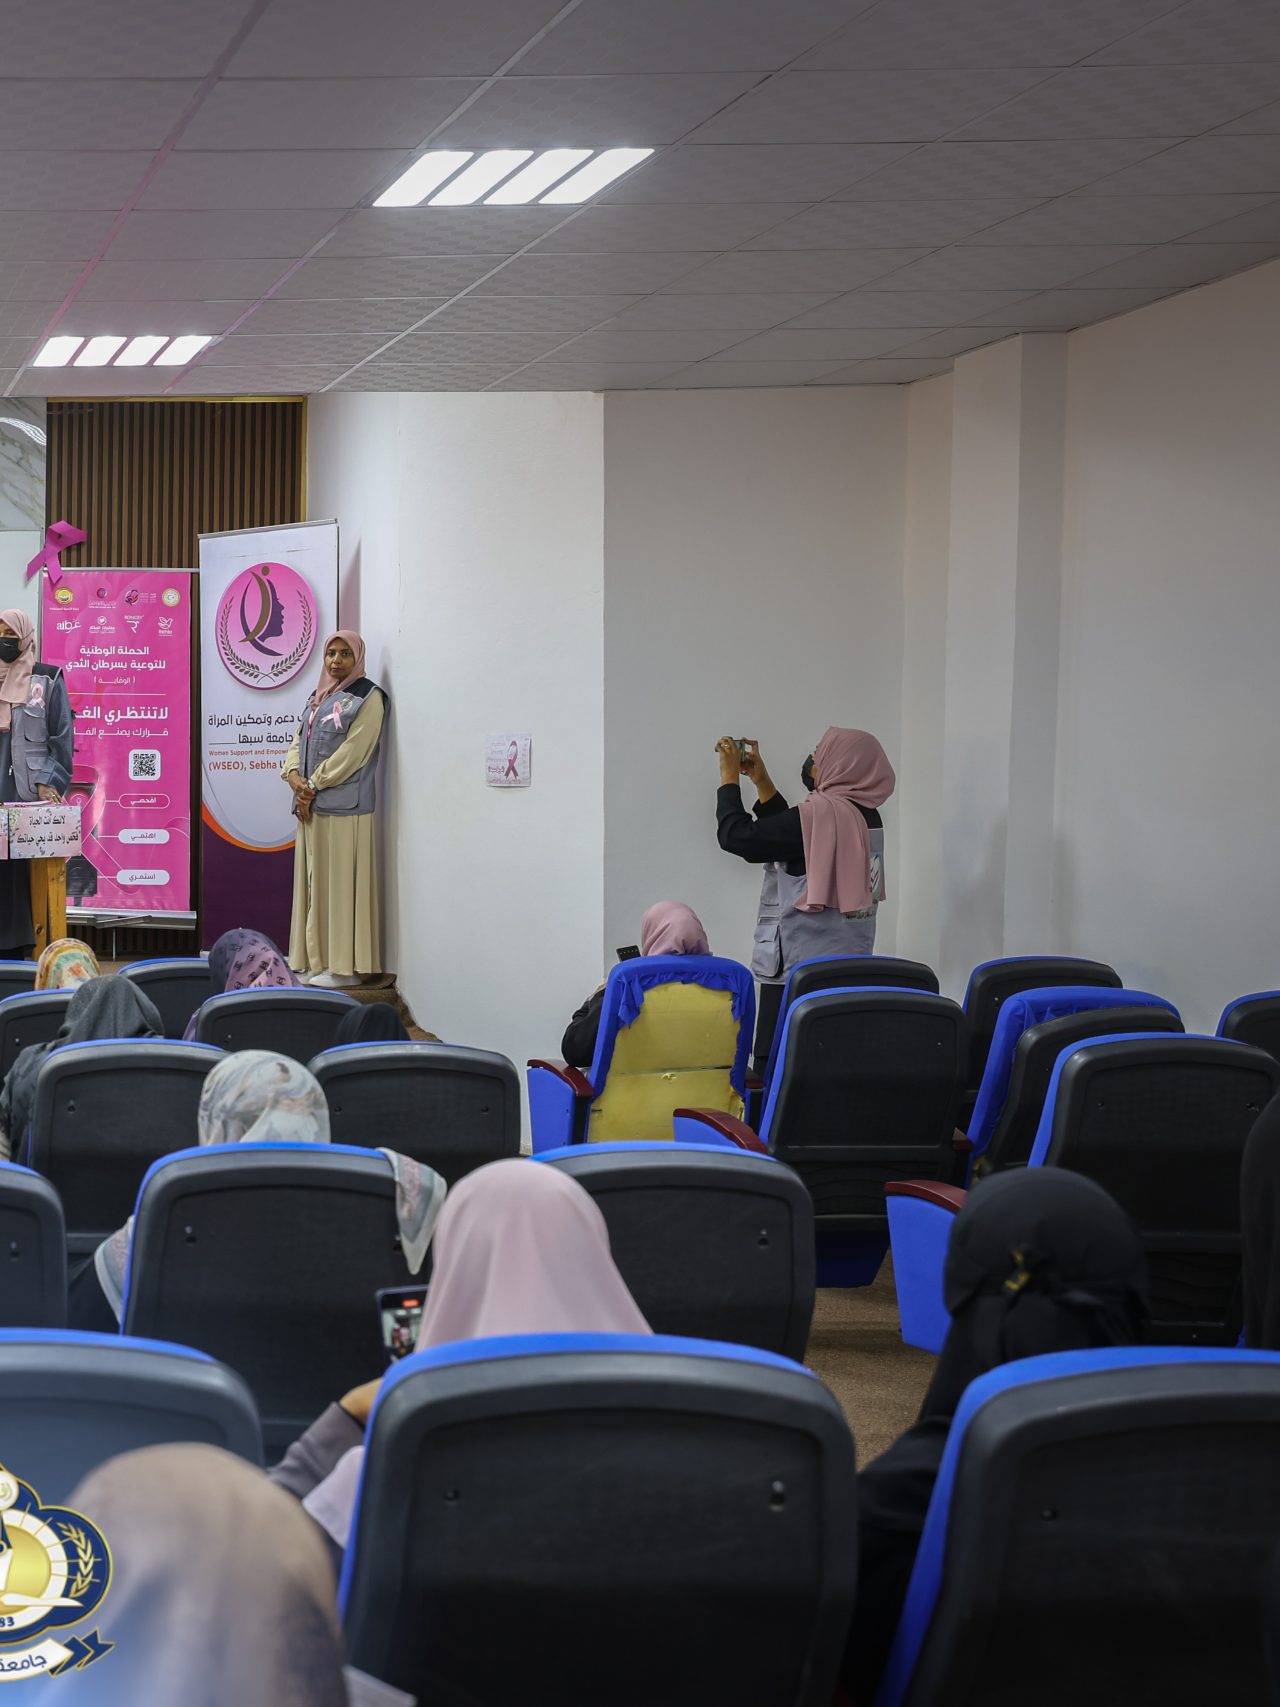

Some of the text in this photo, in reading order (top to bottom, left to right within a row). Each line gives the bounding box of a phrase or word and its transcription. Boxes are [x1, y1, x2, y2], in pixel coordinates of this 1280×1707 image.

[79, 645, 150, 657] الحملة الوطنية
[65, 658, 166, 672] للتوعية بسرطان الثدي
[74, 705, 101, 719] الغ
[235, 713, 272, 727] وتمكين
[274, 714, 295, 726] دعم
[238, 731, 294, 746] جامعة سبها
[230, 749, 253, 757] Support
[208, 761, 247, 772] (WSEO),
[249, 760, 277, 770] Sebha
